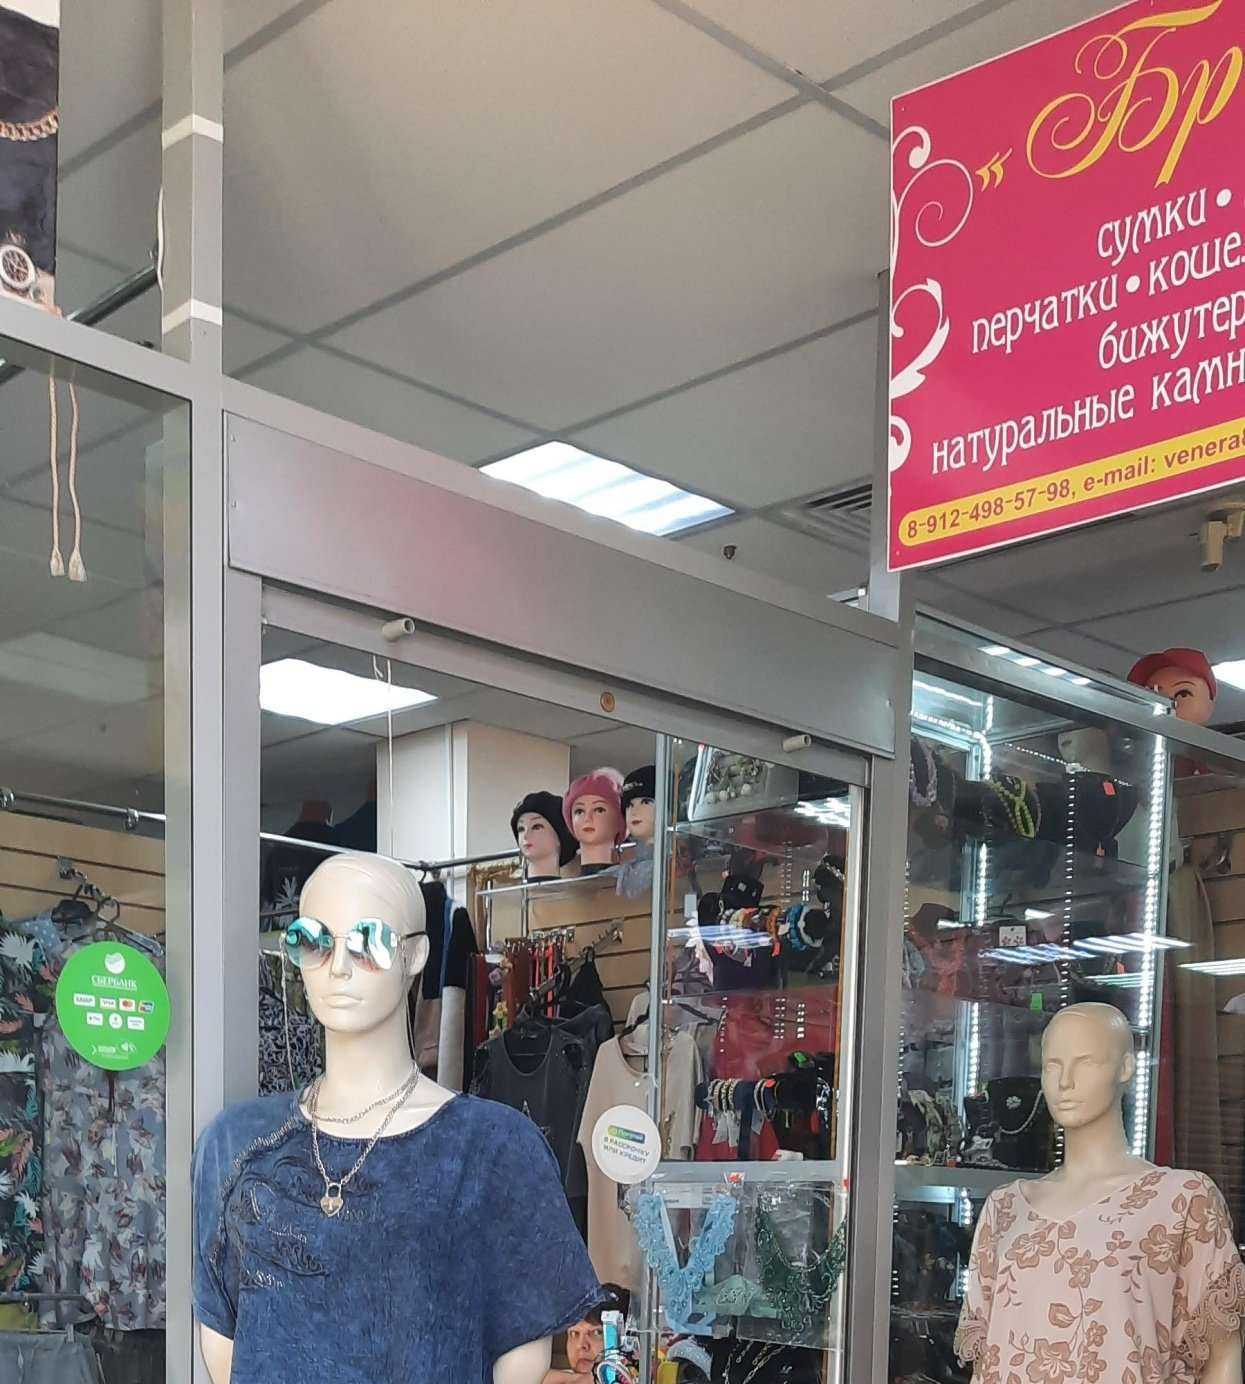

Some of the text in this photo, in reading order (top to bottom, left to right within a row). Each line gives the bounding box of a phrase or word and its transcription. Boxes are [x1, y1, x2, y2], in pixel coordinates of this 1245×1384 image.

[1097, 188, 1208, 266] сумки
[971, 231, 1245, 354] перчатки коше
[931, 383, 1136, 474] натуральные
[907, 479, 1077, 539] 8-912-498-57-98,
[1083, 456, 1156, 491] e-mail:
[91, 975, 138, 990] СБЕРБАНК
